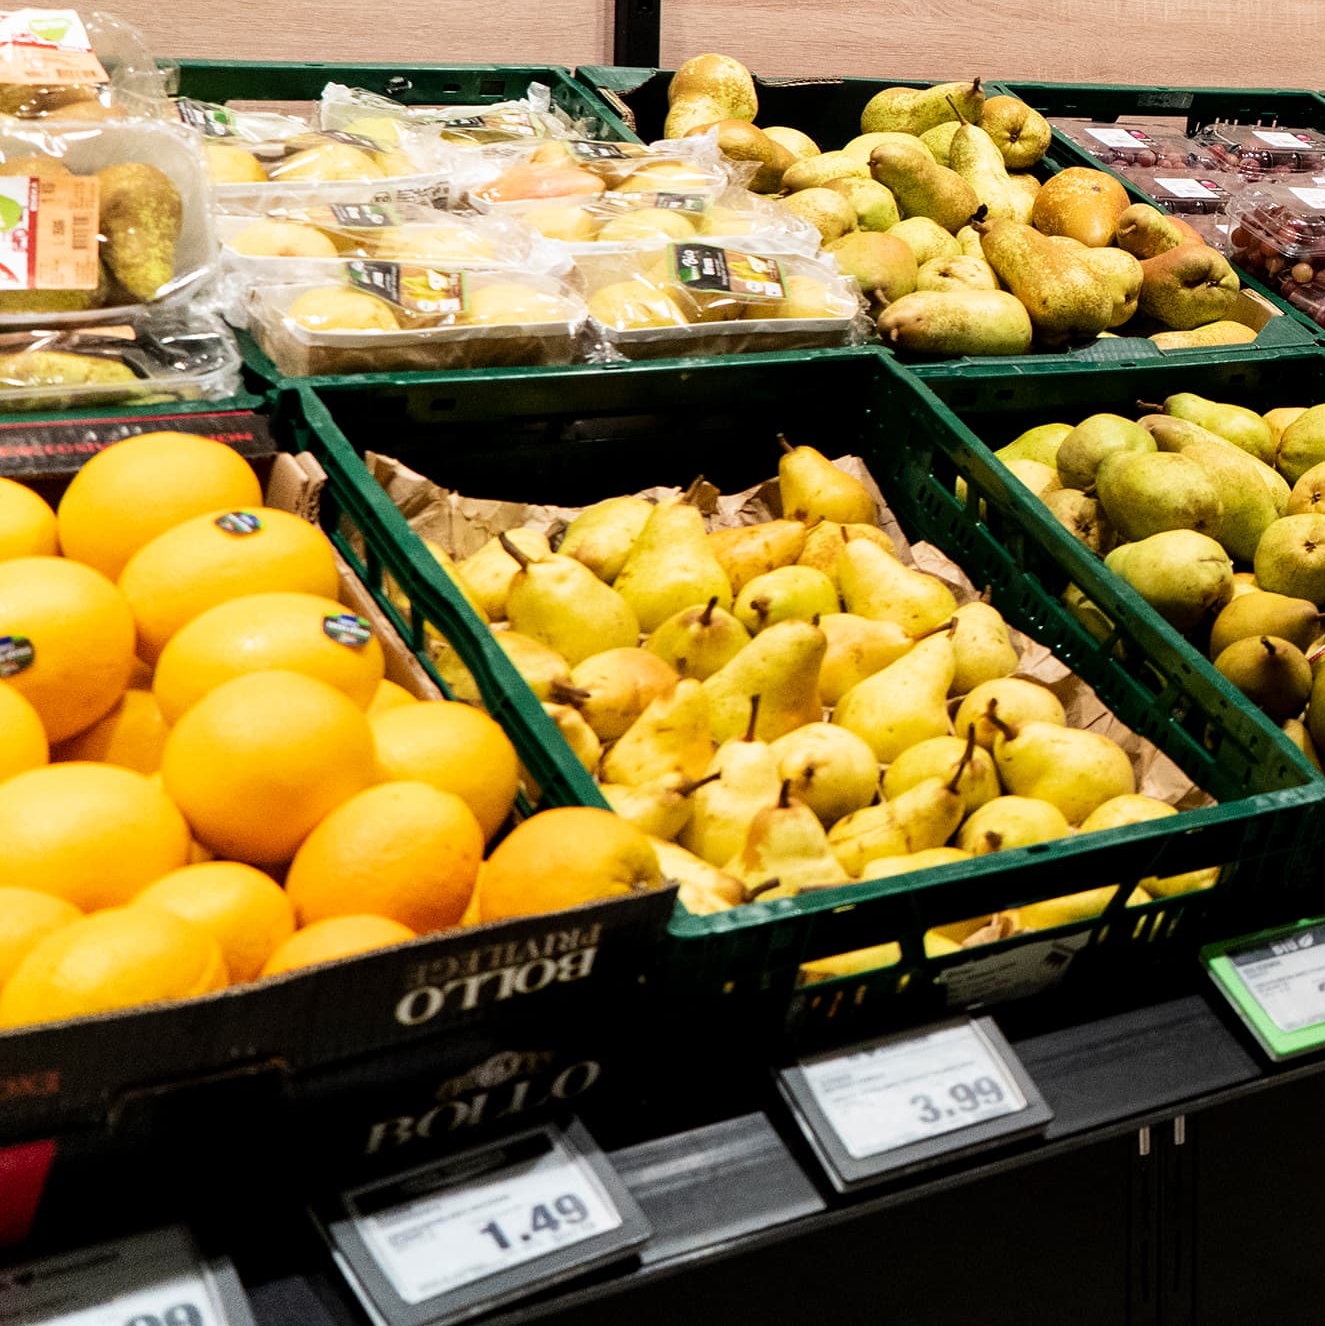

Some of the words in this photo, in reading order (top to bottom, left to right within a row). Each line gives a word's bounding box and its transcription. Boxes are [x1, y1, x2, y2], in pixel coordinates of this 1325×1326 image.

[394, 946, 598, 1026] BOLLO
[910, 1076, 1005, 1124] 3.99
[480, 1193, 589, 1250] 1.49
